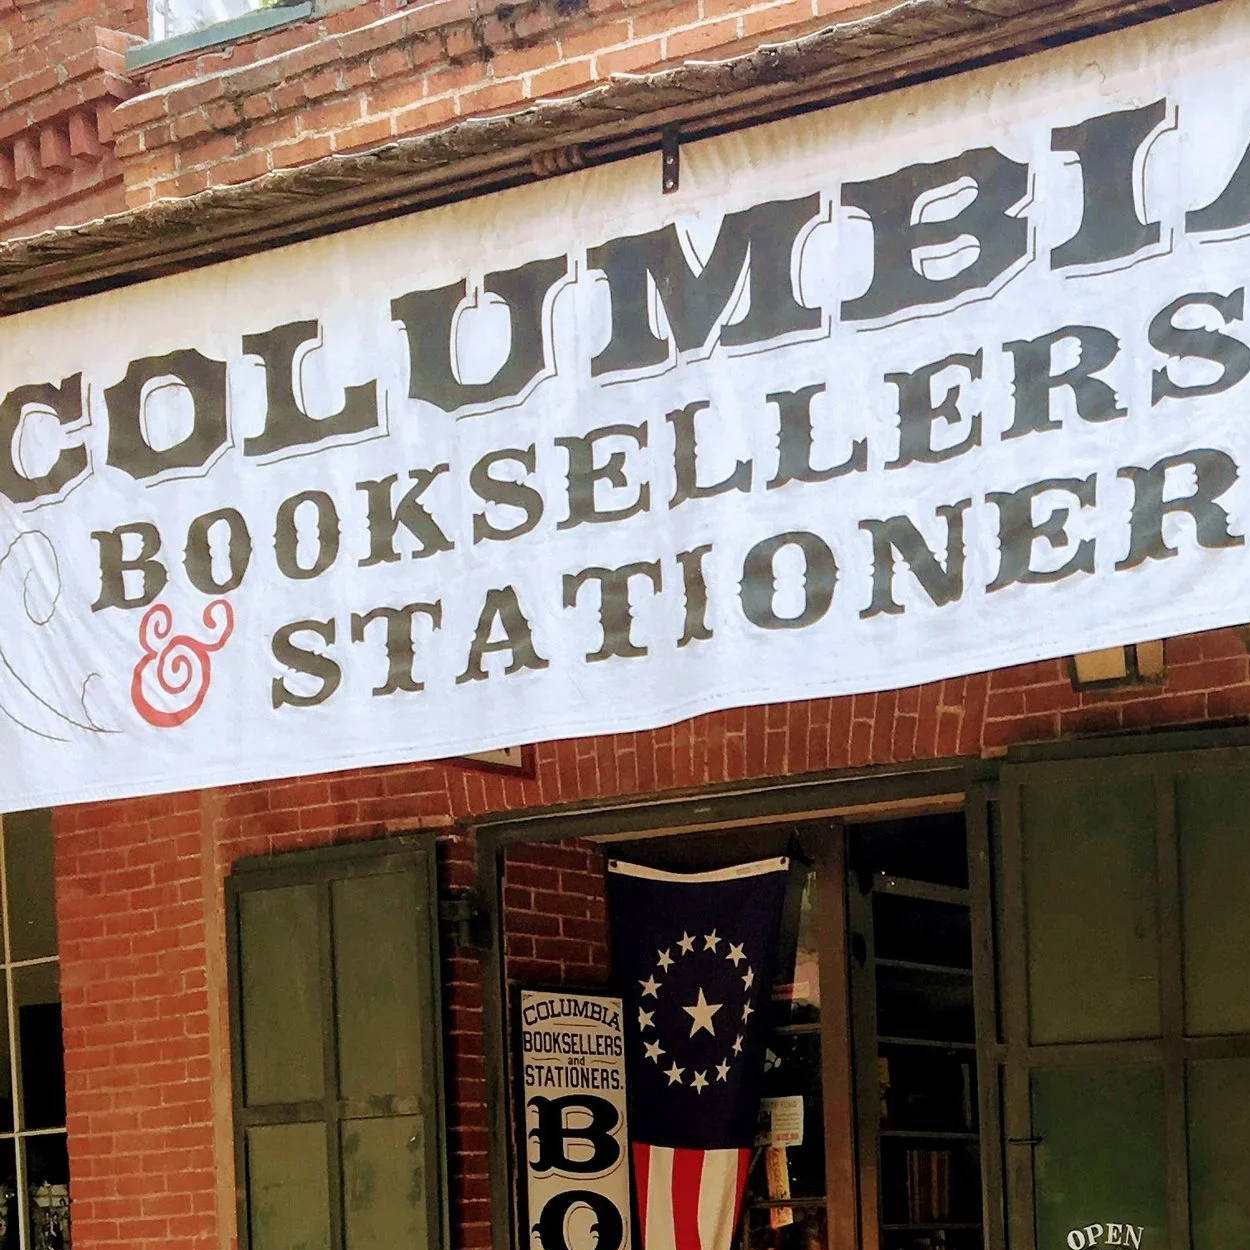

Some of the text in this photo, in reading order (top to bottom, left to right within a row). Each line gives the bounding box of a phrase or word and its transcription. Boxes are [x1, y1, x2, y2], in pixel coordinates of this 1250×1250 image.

[131, 599, 235, 728] &
[523, 998, 622, 1032] COLUMBIA
[523, 1031, 623, 1057] BOOKSELLERS
[567, 1056, 586, 1066] and
[524, 1064, 625, 1090] STATIONERS.
[1067, 1223, 1144, 1250] OPEN
